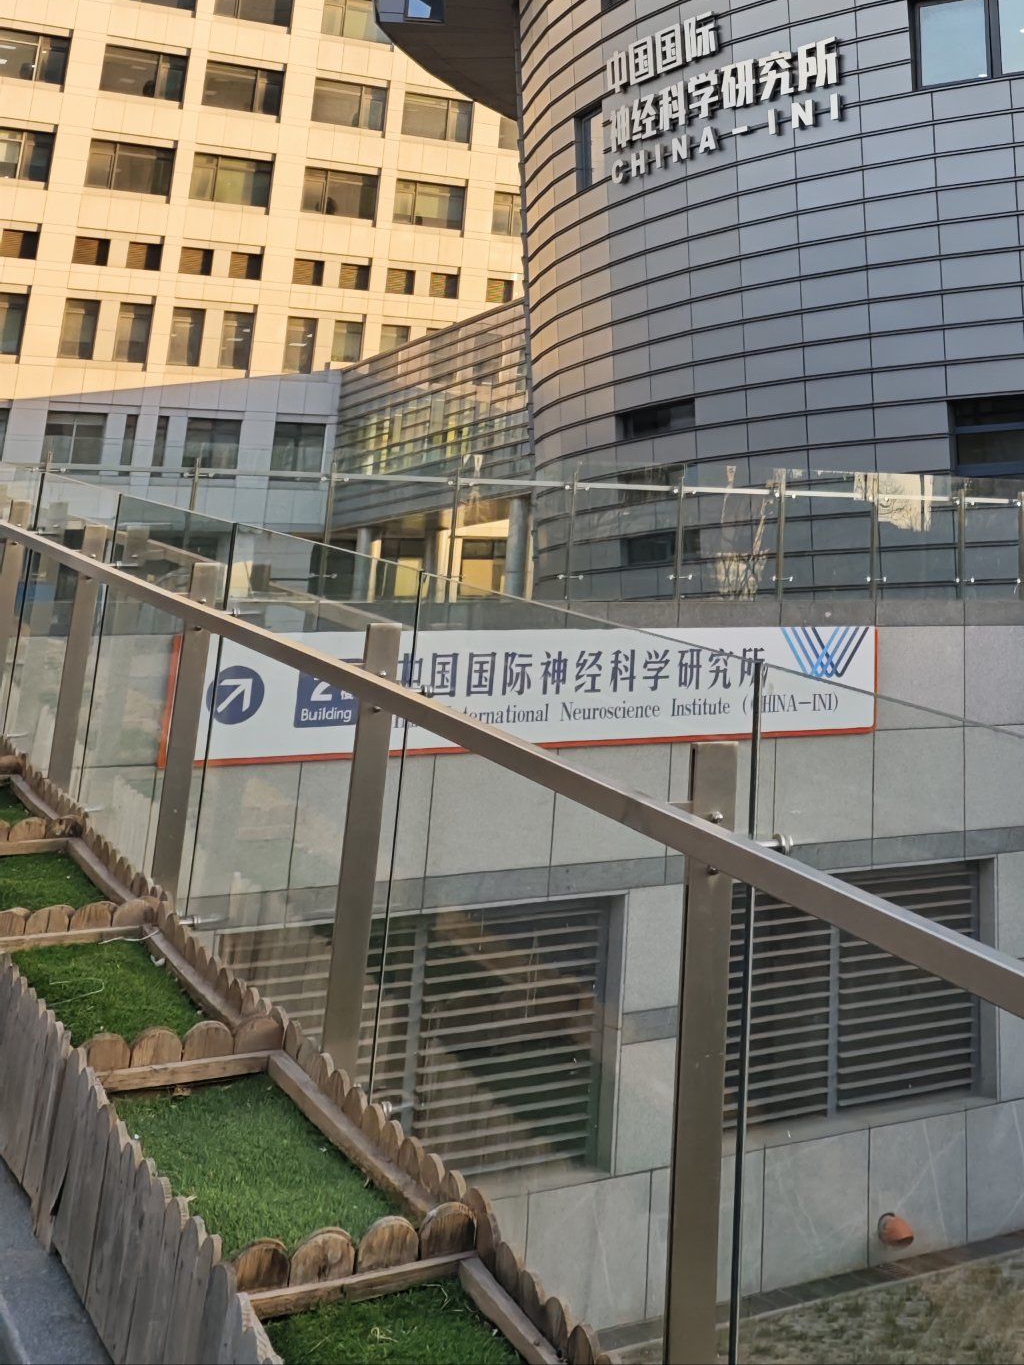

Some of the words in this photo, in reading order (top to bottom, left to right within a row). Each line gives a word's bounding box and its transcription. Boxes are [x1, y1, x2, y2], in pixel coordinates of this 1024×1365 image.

[606, 10, 718, 93] 中国国际
[609, 36, 839, 153] 神经科学研究所
[398, 647, 767, 697] 中国国际神经科学研究所
[300, 707, 352, 723] Building
[447, 702, 549, 726] ternational
[560, 700, 660, 722] Neuroscience
[671, 697, 731, 717] Institute
[742, 692, 839, 715] (HINA-INI)
